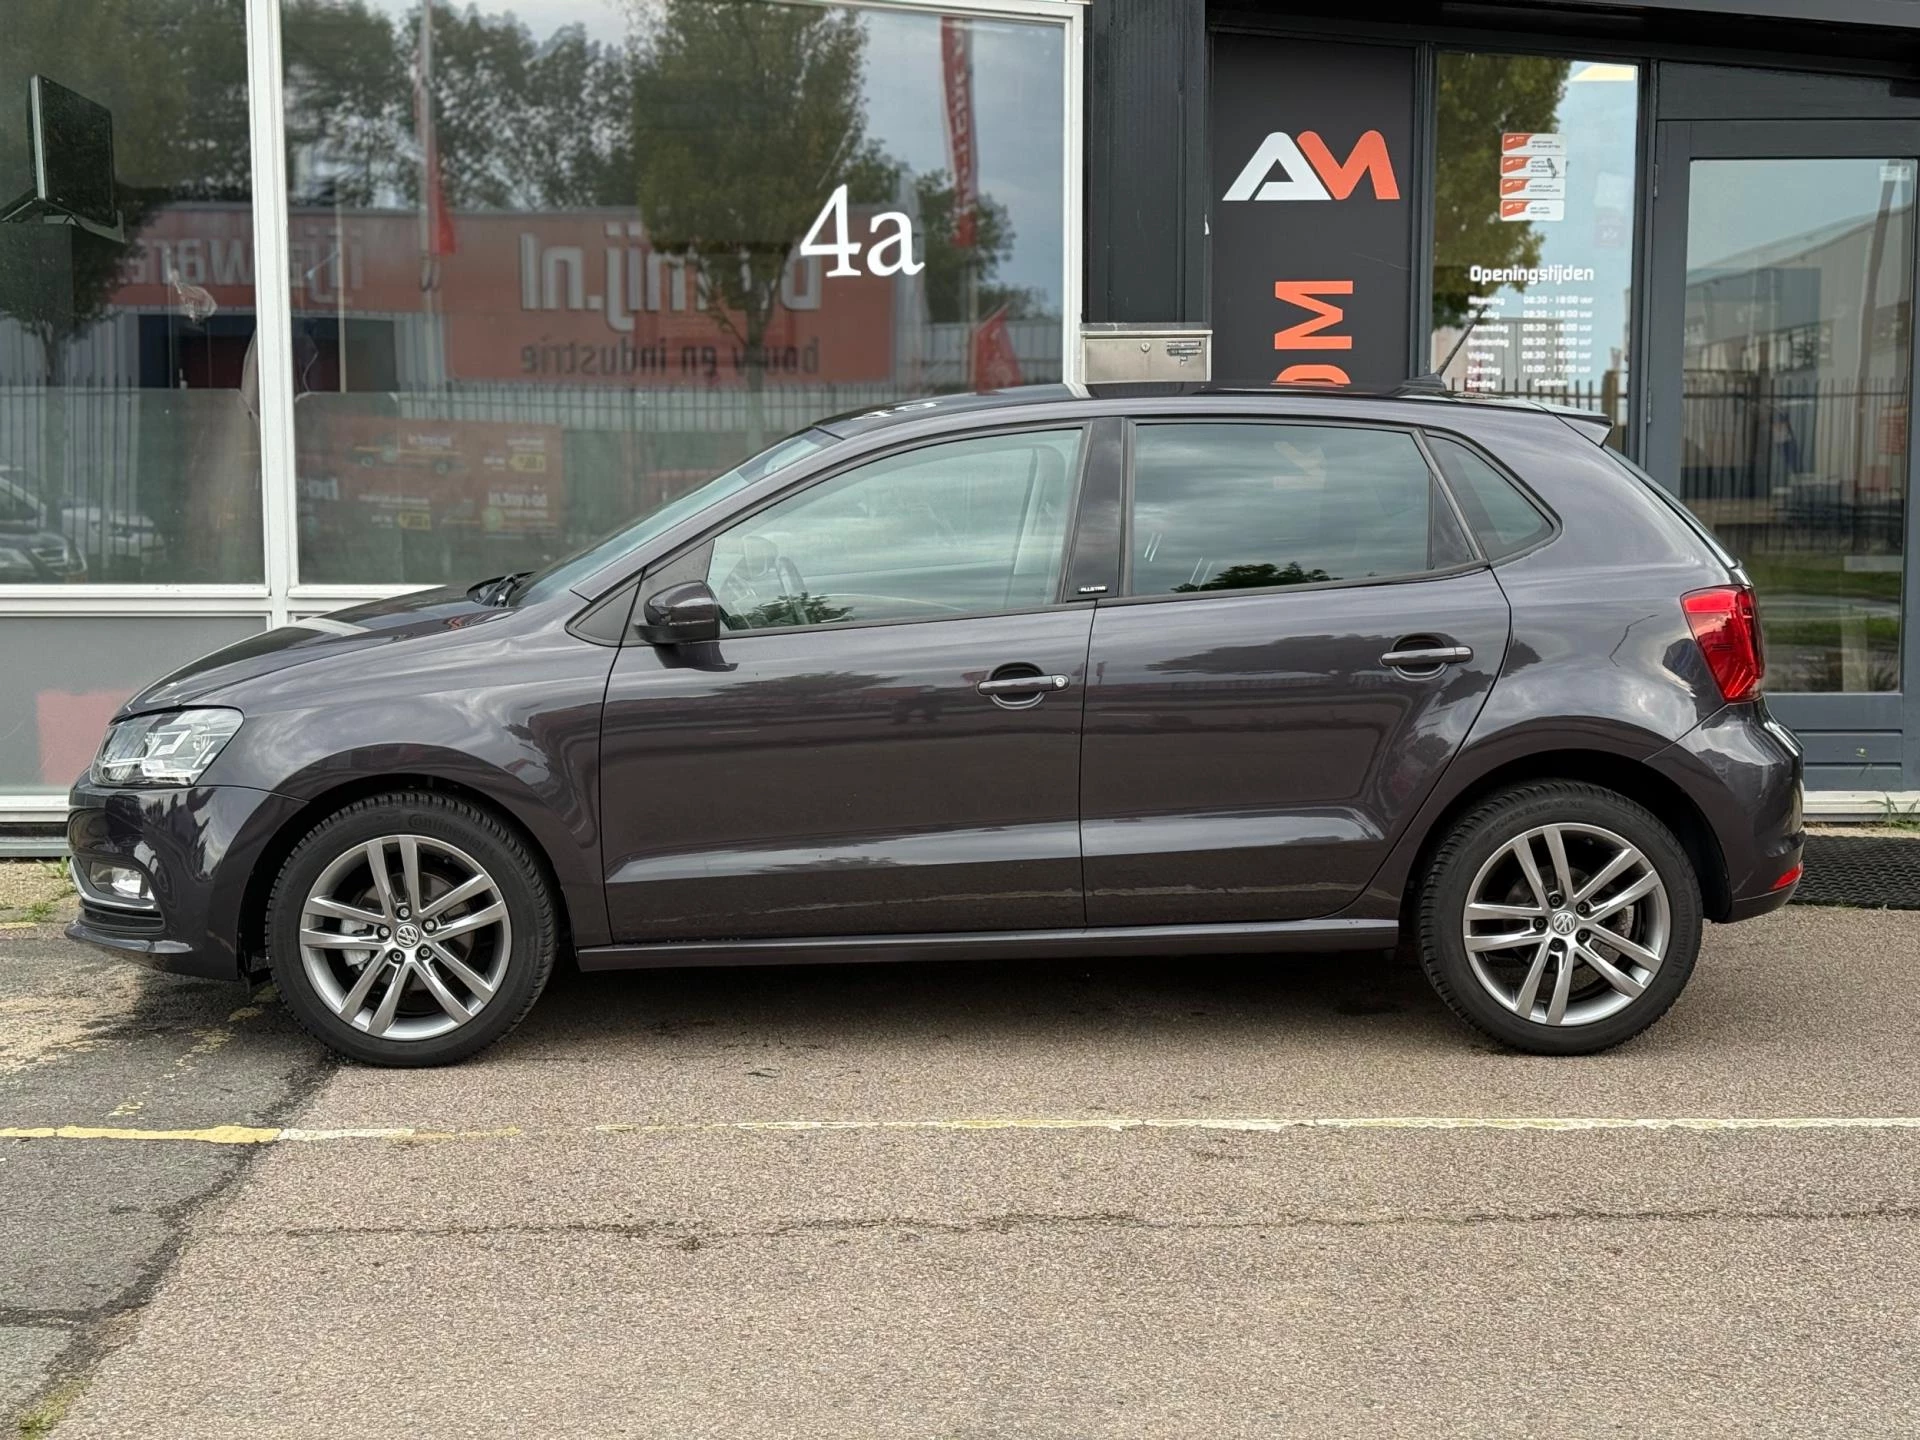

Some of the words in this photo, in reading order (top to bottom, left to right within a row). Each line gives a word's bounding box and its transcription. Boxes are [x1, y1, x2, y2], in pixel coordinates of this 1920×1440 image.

[1222, 130, 1400, 201] AM
[799, 184, 925, 278] 4a
[1469, 265, 1594, 285] Openingstijden
[1467, 352, 1494, 361] Vrijdag
[1467, 366, 1501, 375] Zaterdag
[1467, 380, 1496, 388] Zondag
